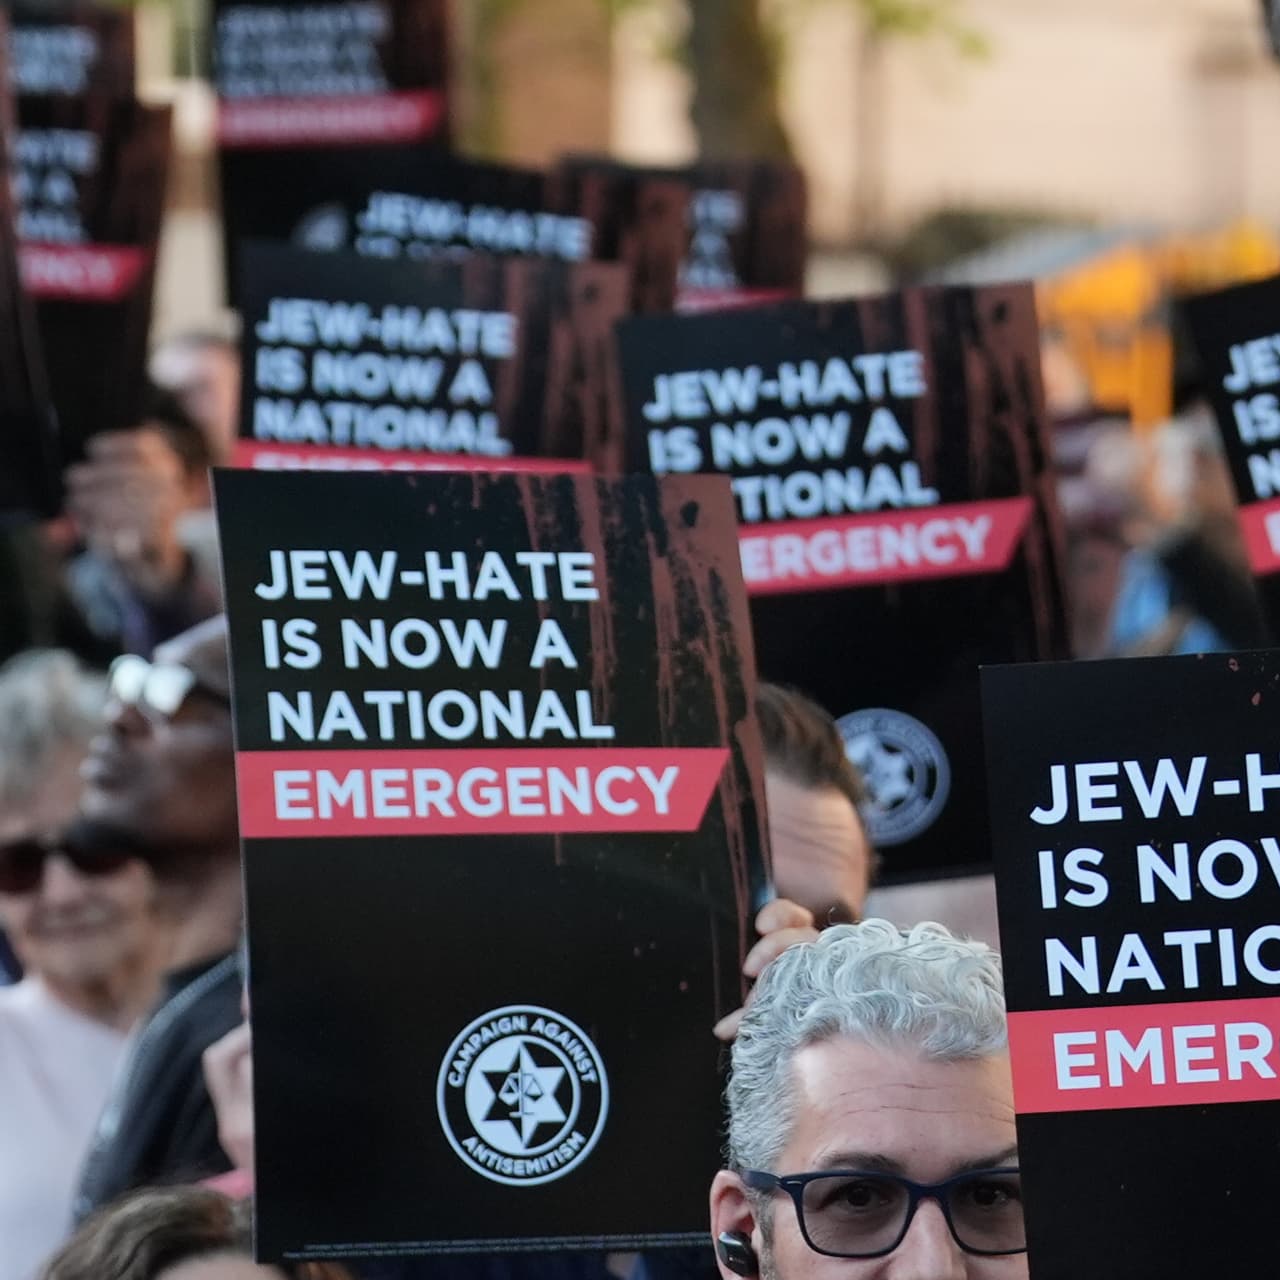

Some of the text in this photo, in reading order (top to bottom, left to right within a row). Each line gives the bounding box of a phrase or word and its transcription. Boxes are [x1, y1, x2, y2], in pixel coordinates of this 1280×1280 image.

[258, 300, 514, 356] JEW-HATE
[258, 348, 491, 401] IS NOW A
[644, 352, 924, 420] JEW-HATE
[256, 401, 512, 455] NATIONAL
[650, 409, 907, 471] IS NOW A
[733, 464, 937, 520] TIONAL
[255, 550, 598, 601] JEW-HATE
[742, 517, 990, 581] ERGENCY
[262, 619, 576, 669] IS NOW A
[268, 690, 614, 742] NATIONAL
[273, 766, 679, 820] EMERGENCY
[1039, 848, 1109, 909] IS
[447, 1015, 598, 1088] CAMPAIGN AGAINST
[462, 1131, 586, 1176] ANTISEMITISM
